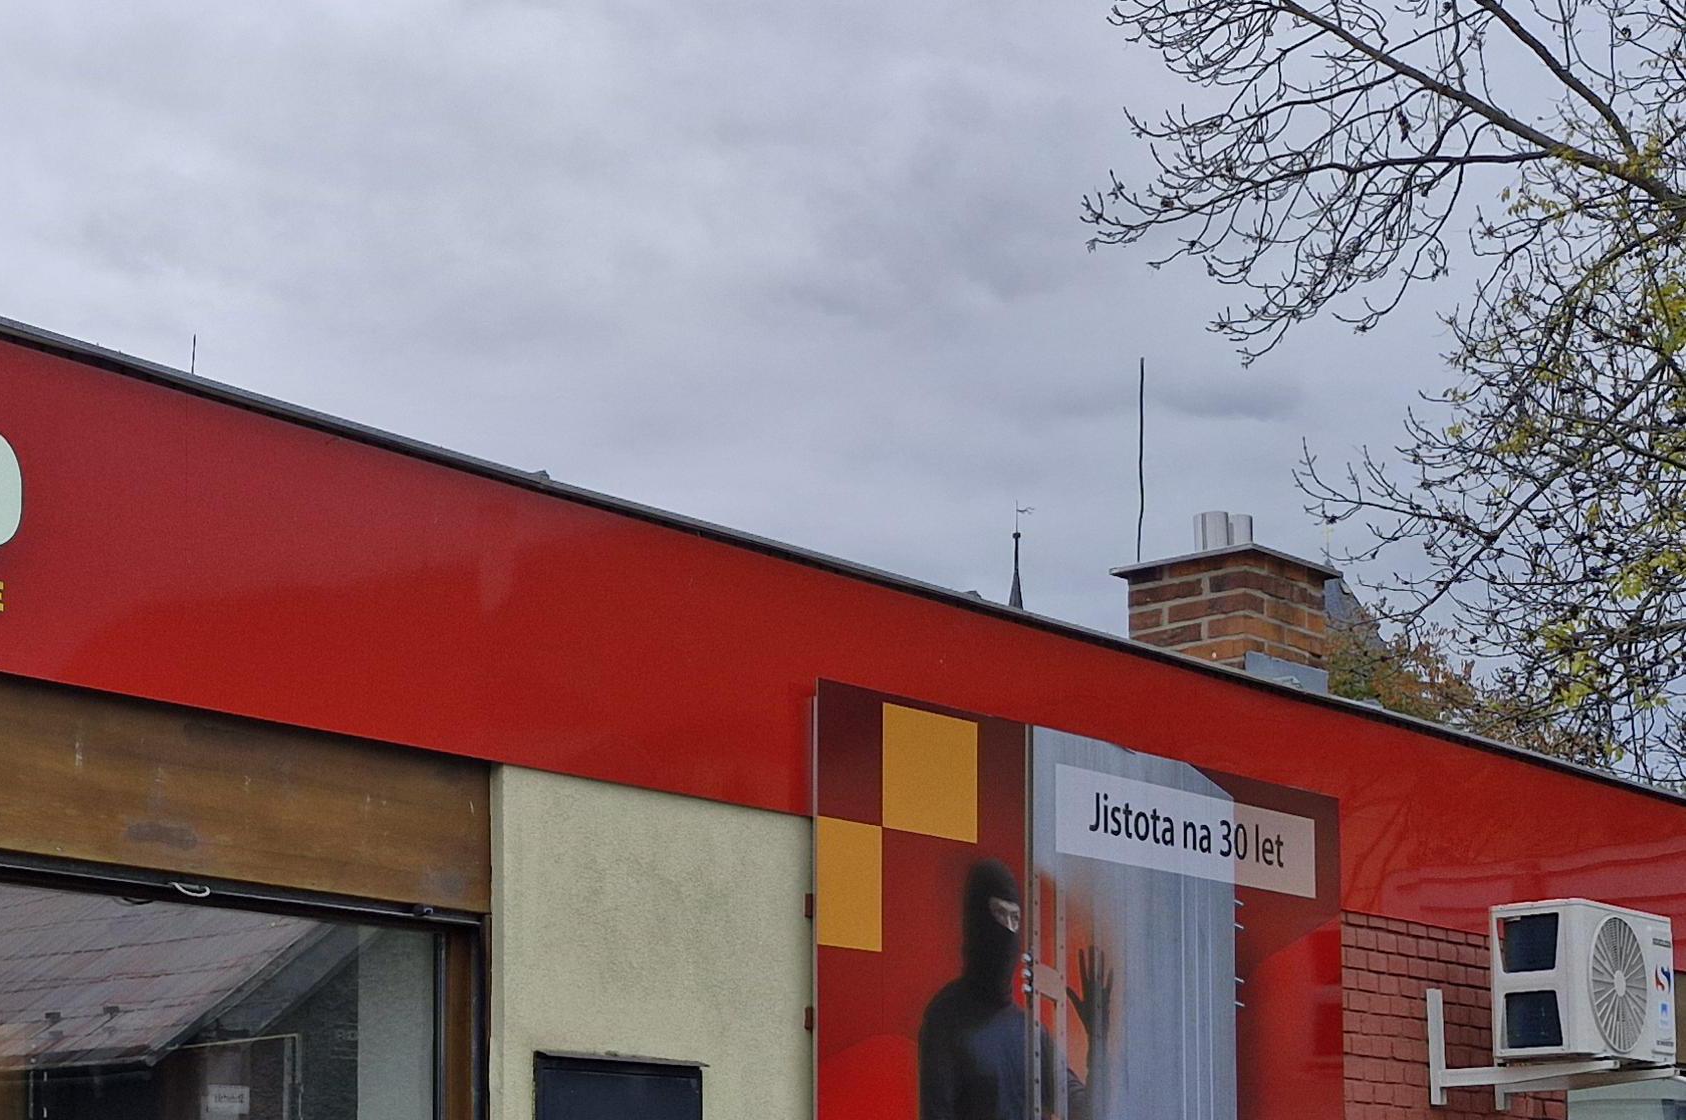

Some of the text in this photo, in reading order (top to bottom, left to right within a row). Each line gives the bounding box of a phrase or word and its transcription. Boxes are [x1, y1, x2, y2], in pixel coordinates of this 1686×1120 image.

[1089, 792, 1284, 868] Jistota na 30 let
